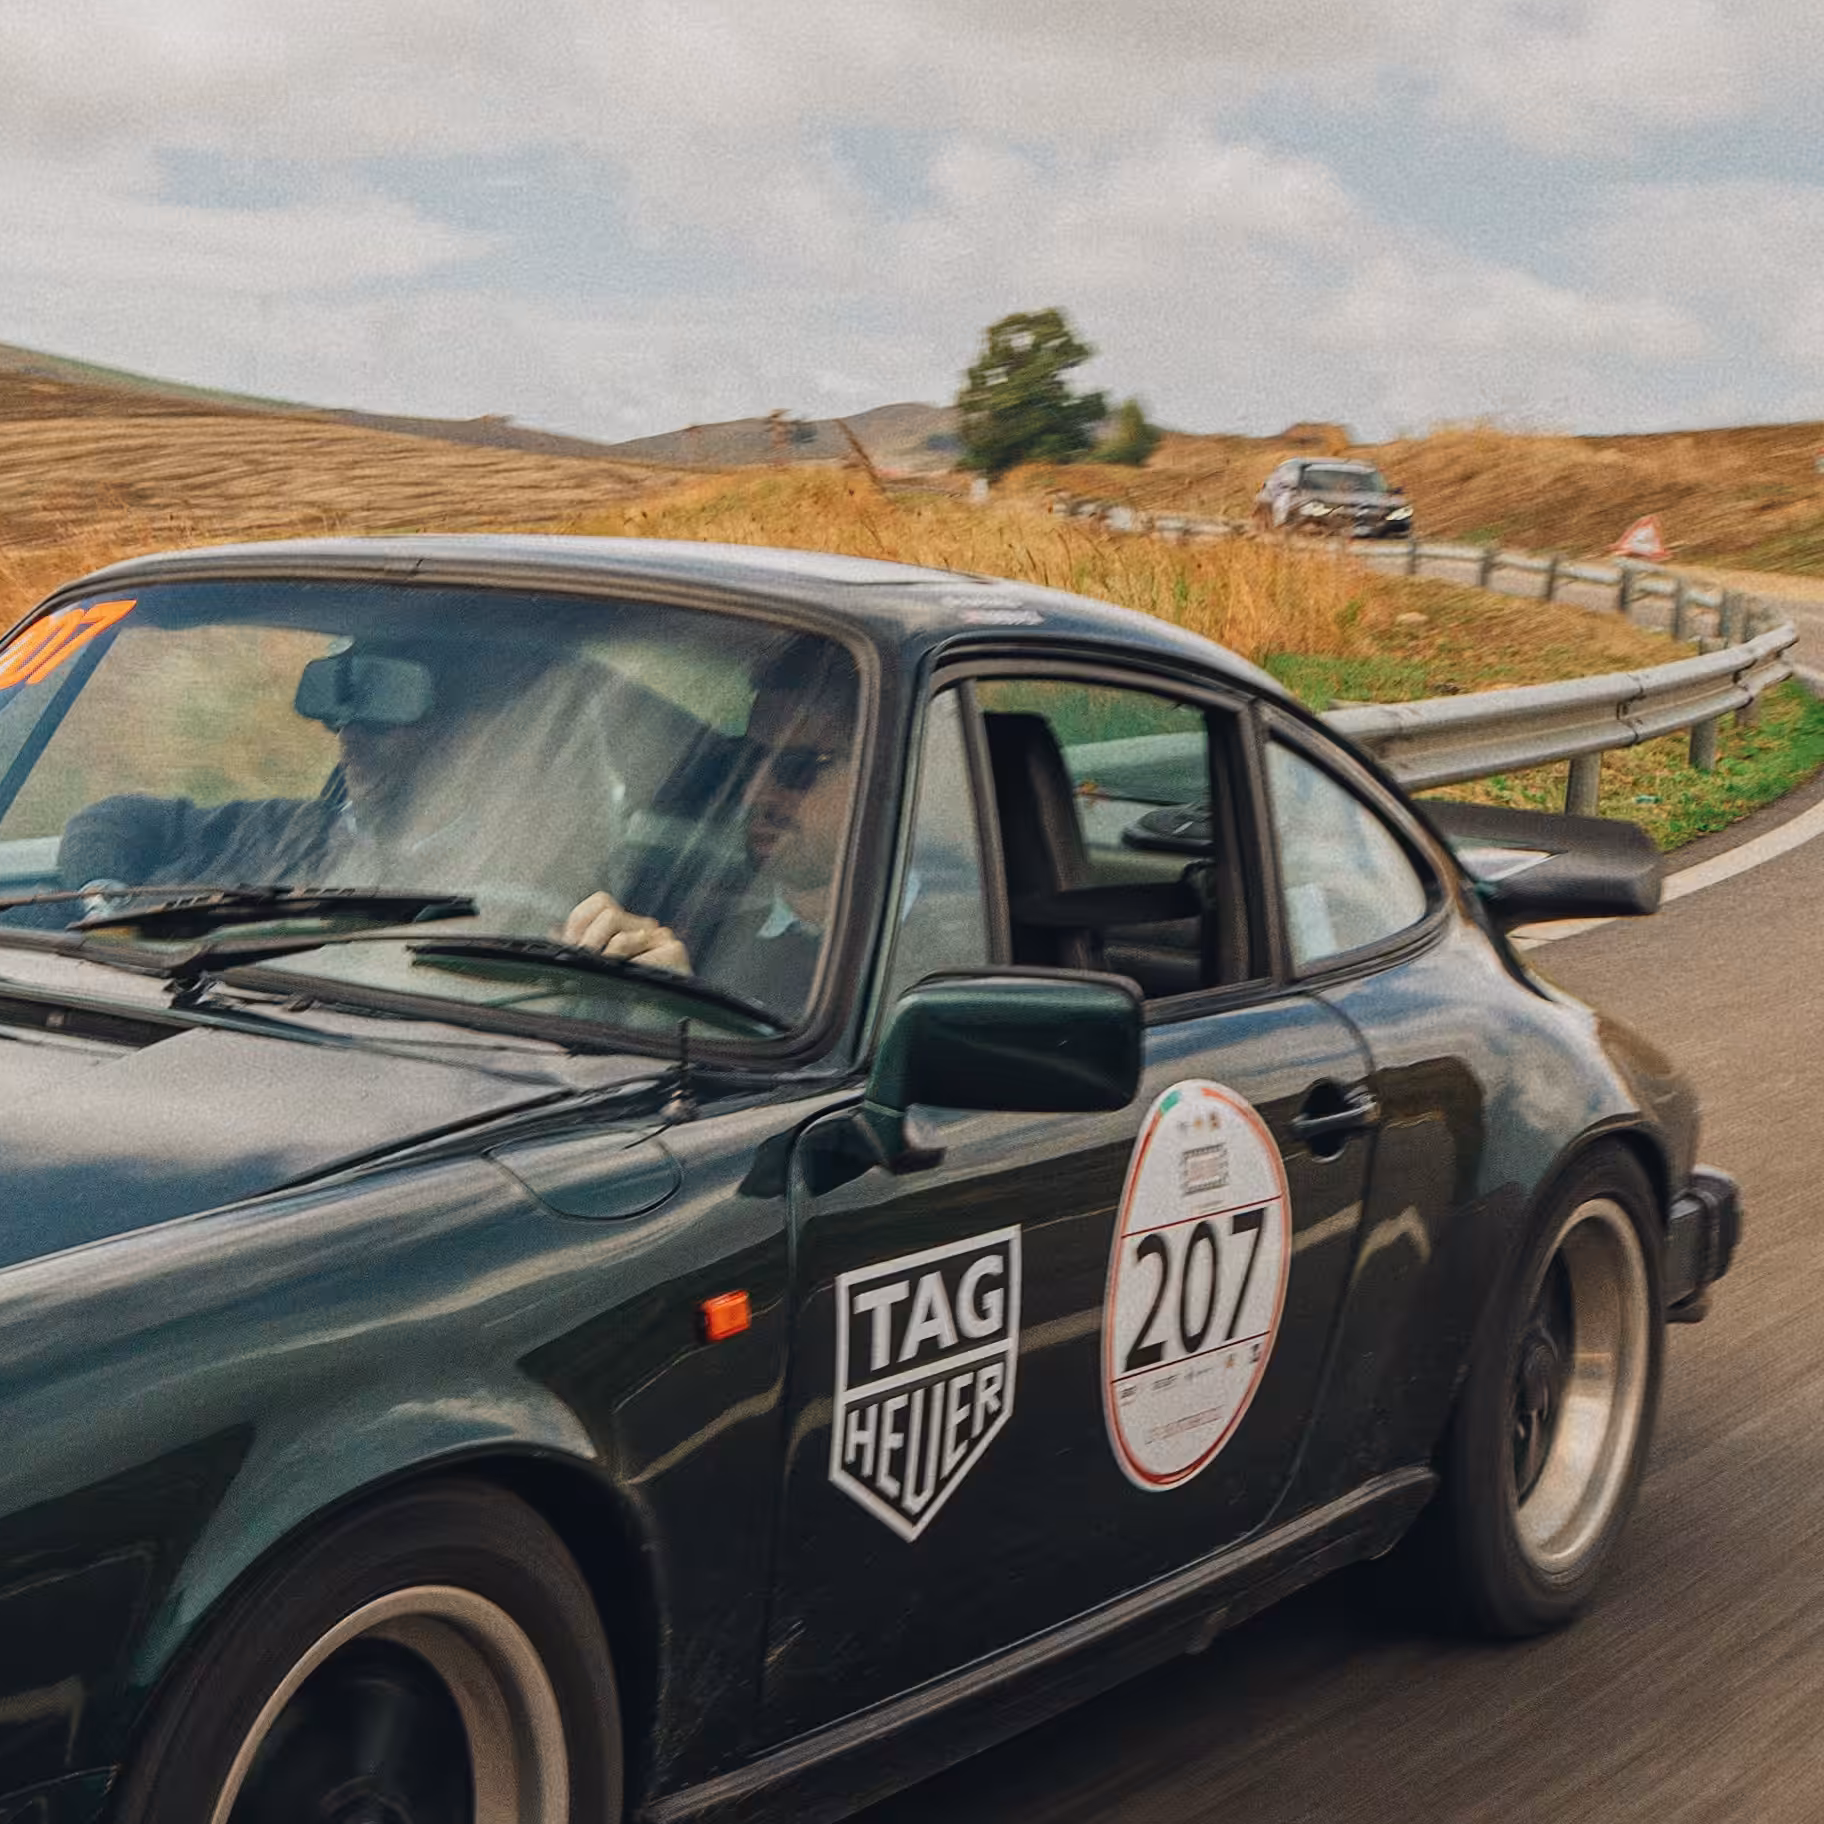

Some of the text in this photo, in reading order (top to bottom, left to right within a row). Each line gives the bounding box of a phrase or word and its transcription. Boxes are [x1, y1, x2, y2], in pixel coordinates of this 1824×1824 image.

[853, 1253, 1004, 1371] TAG
[1124, 1207, 1267, 1372] 207
[844, 1361, 1004, 1515] HEUER
